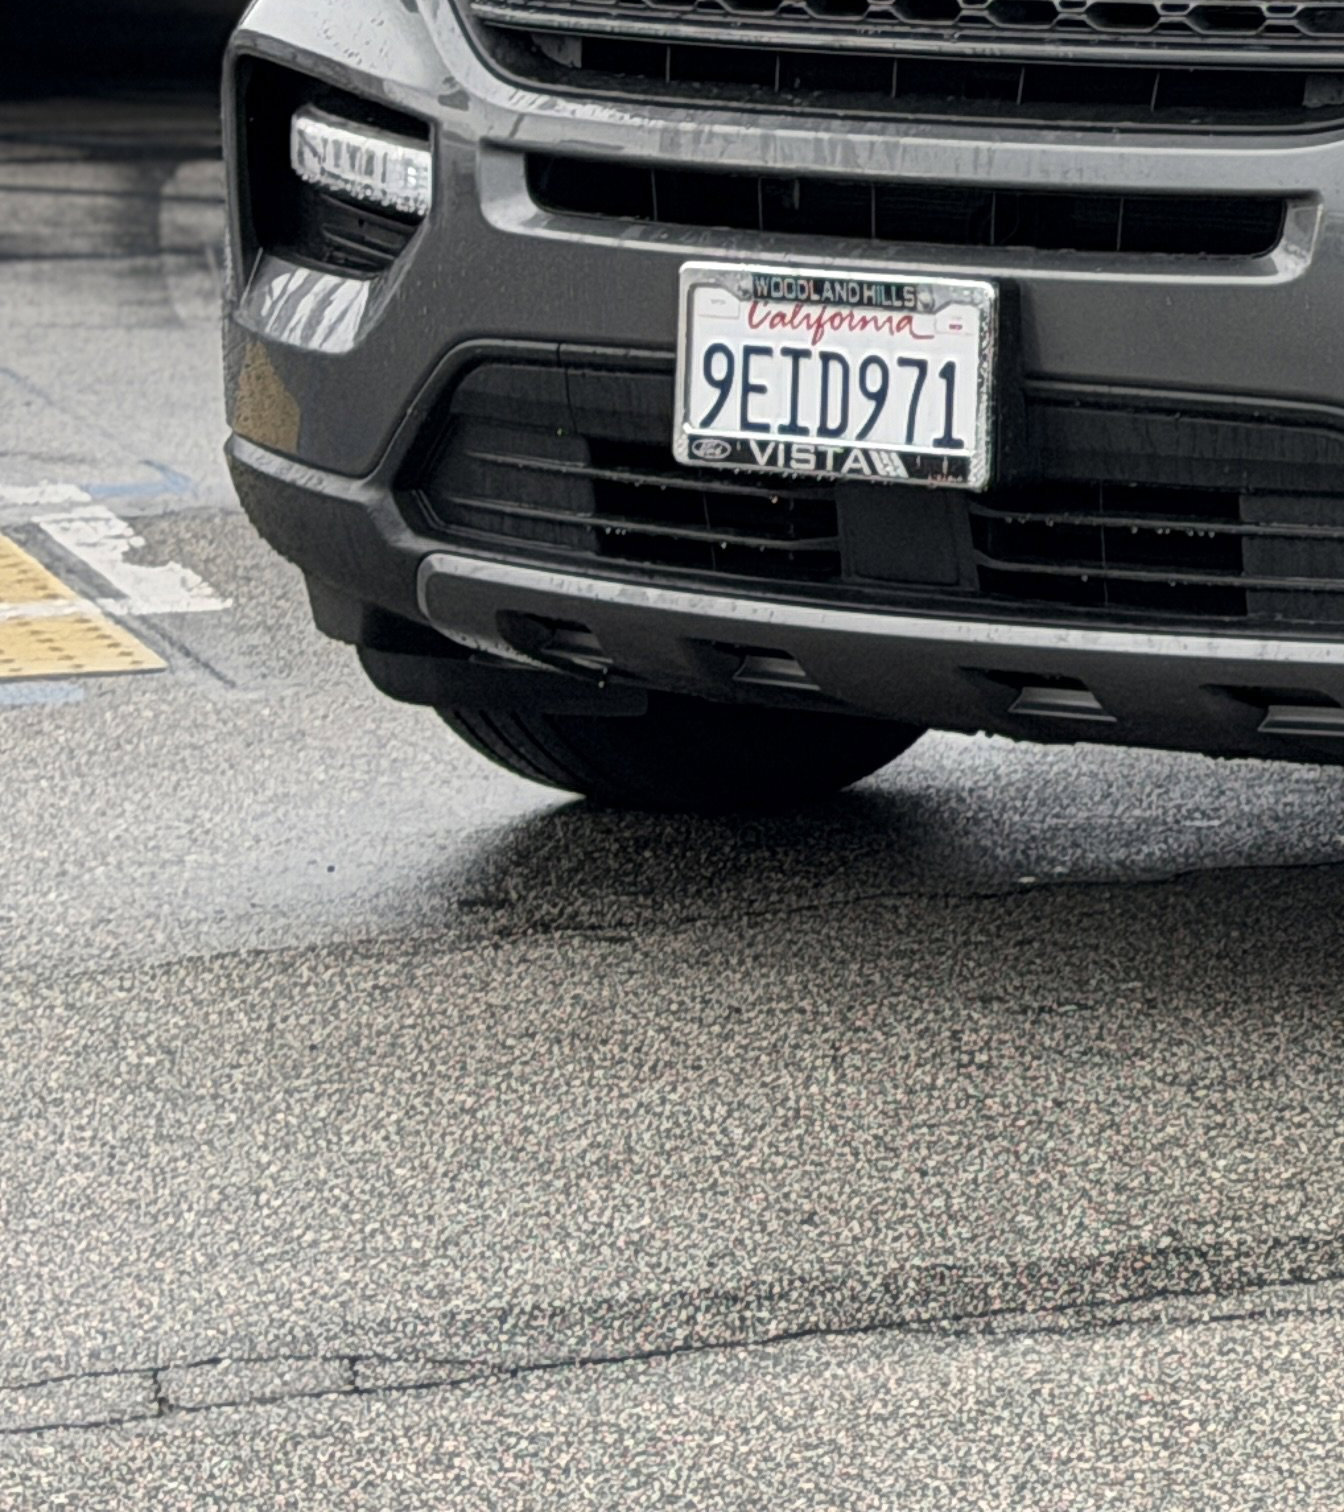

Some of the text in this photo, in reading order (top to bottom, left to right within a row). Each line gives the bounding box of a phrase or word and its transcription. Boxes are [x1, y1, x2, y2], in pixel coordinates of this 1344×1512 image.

[753, 275, 916, 308] WOODLAND HILLS
[747, 301, 935, 346] California
[699, 342, 965, 450] 9EID971
[749, 439, 873, 477] VISTA
